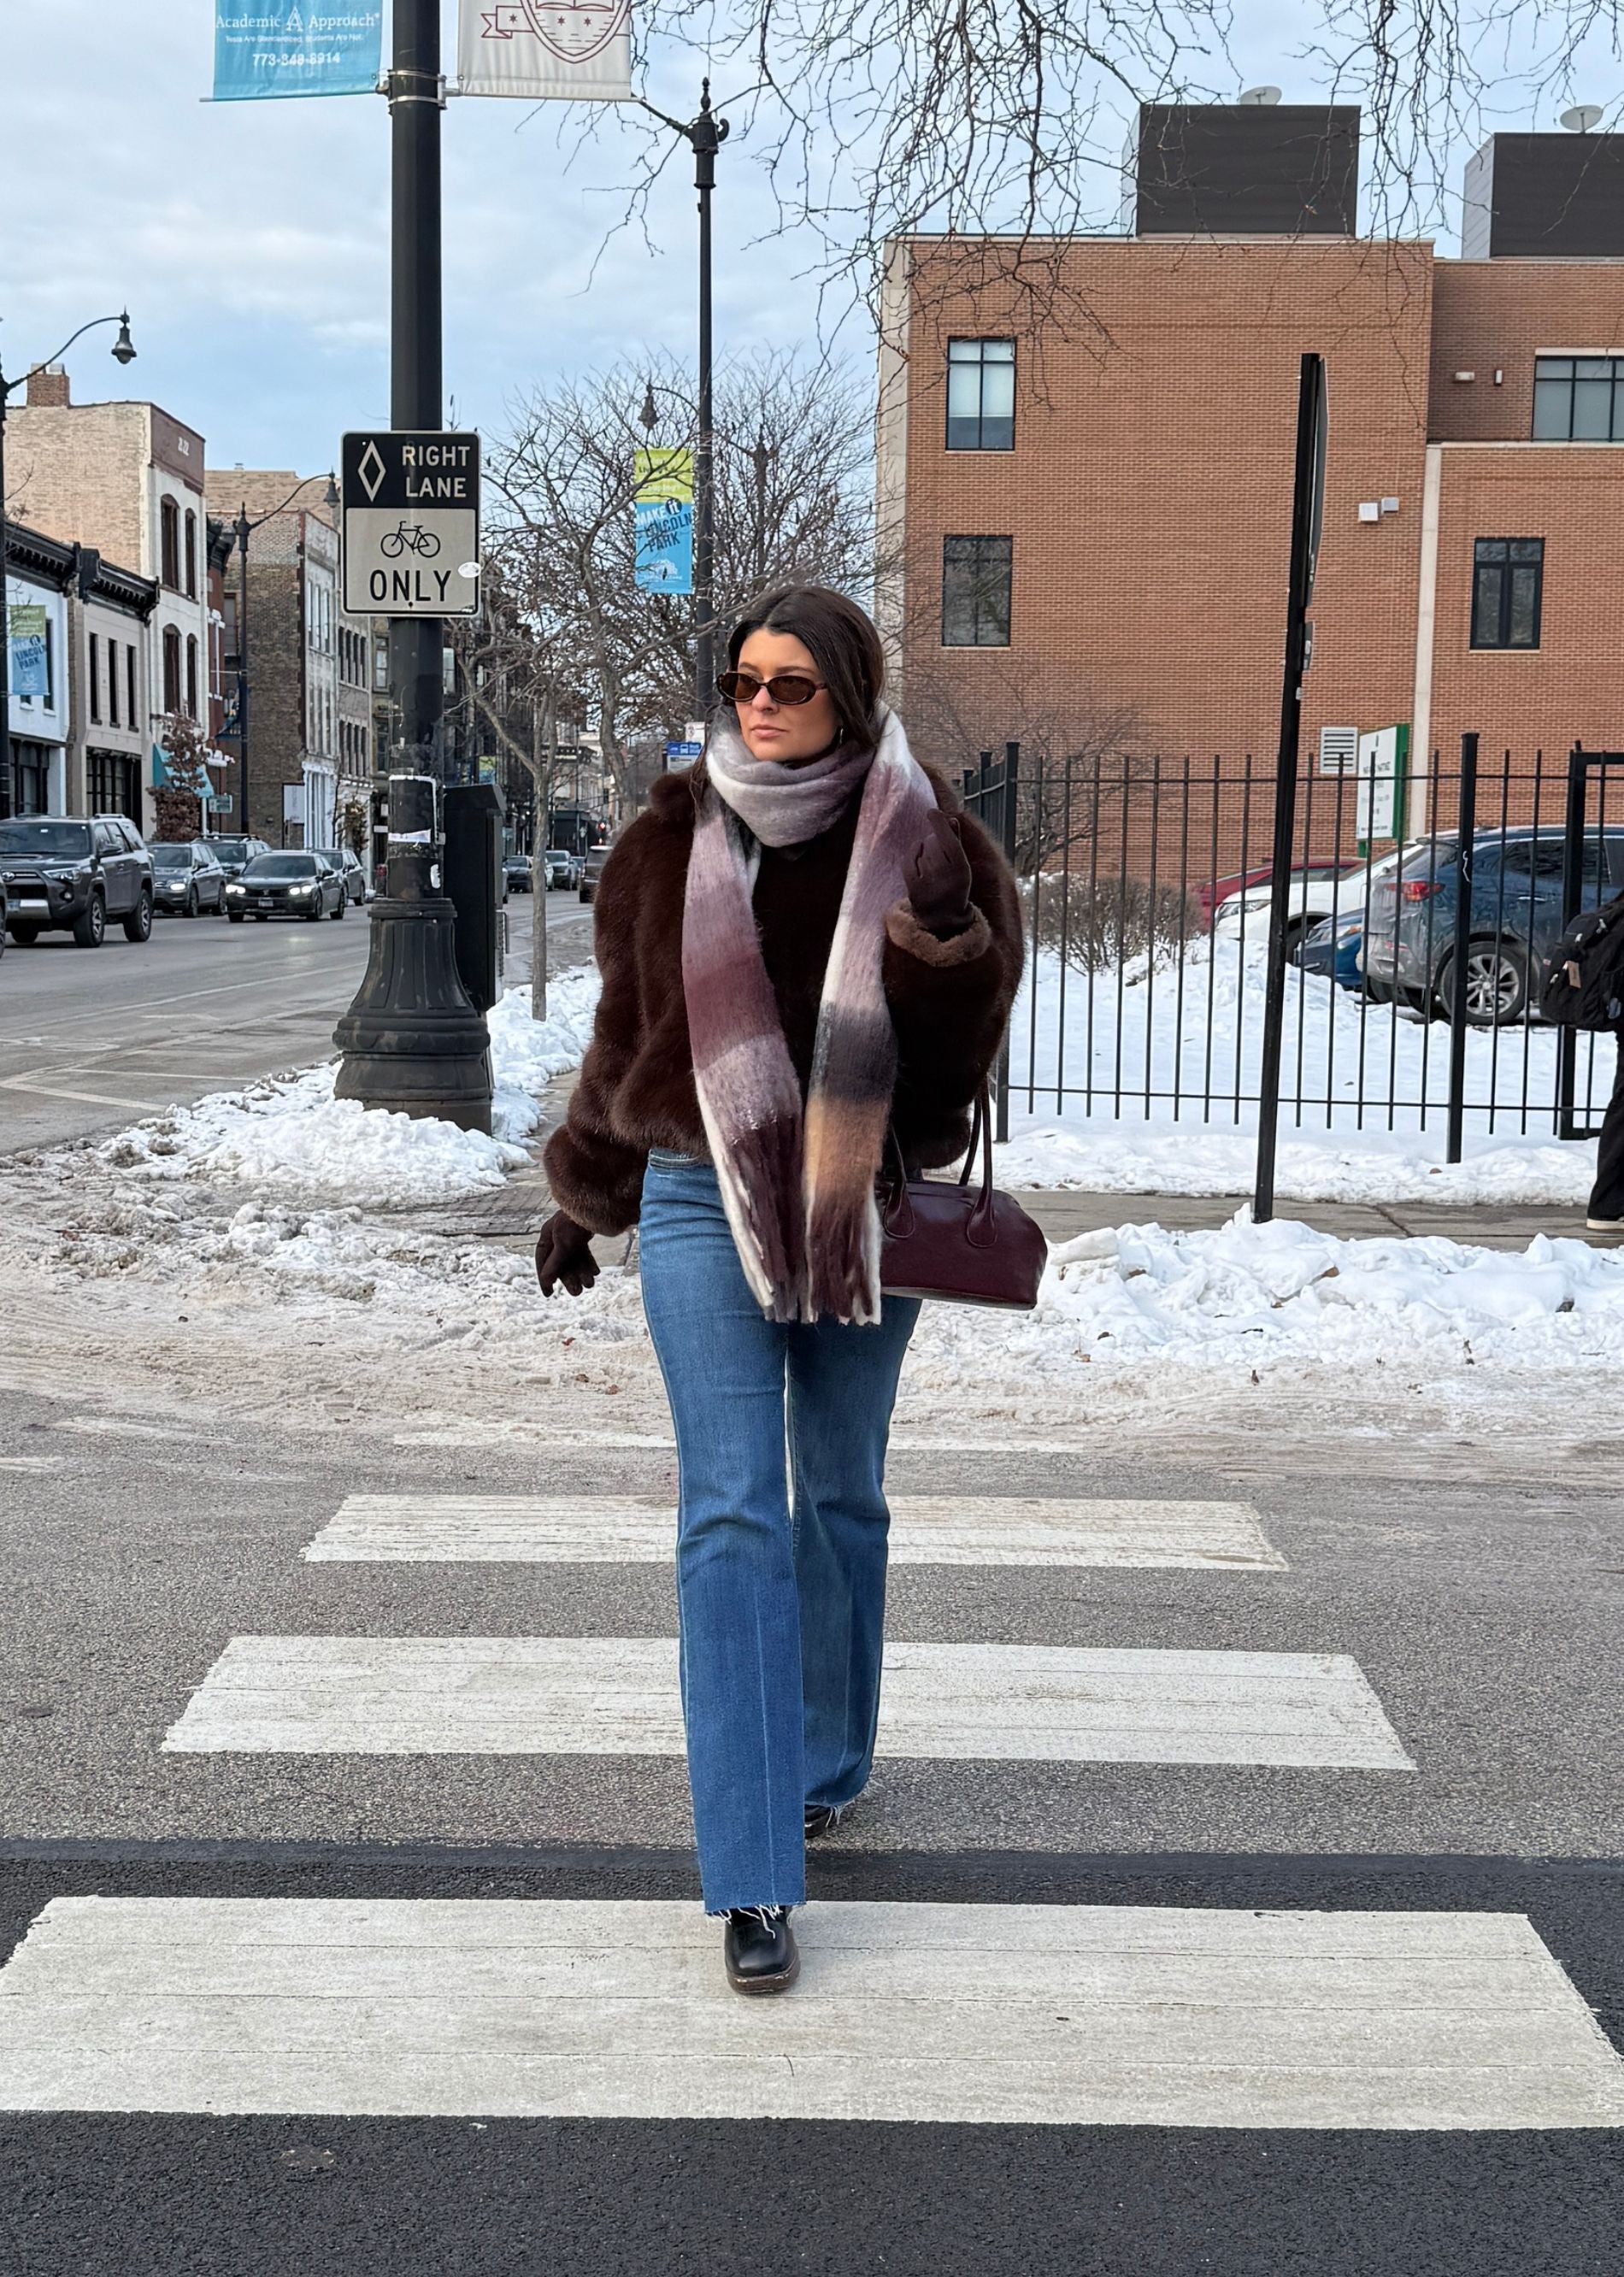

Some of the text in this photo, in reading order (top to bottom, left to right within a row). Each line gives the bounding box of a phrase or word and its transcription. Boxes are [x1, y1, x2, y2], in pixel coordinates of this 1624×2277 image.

[216, 13, 280, 27] Academic
[402, 445, 470, 467] RIGHT
[405, 477, 467, 497] LANE
[649, 532, 680, 552] PARK
[369, 569, 451, 602] ONLY
